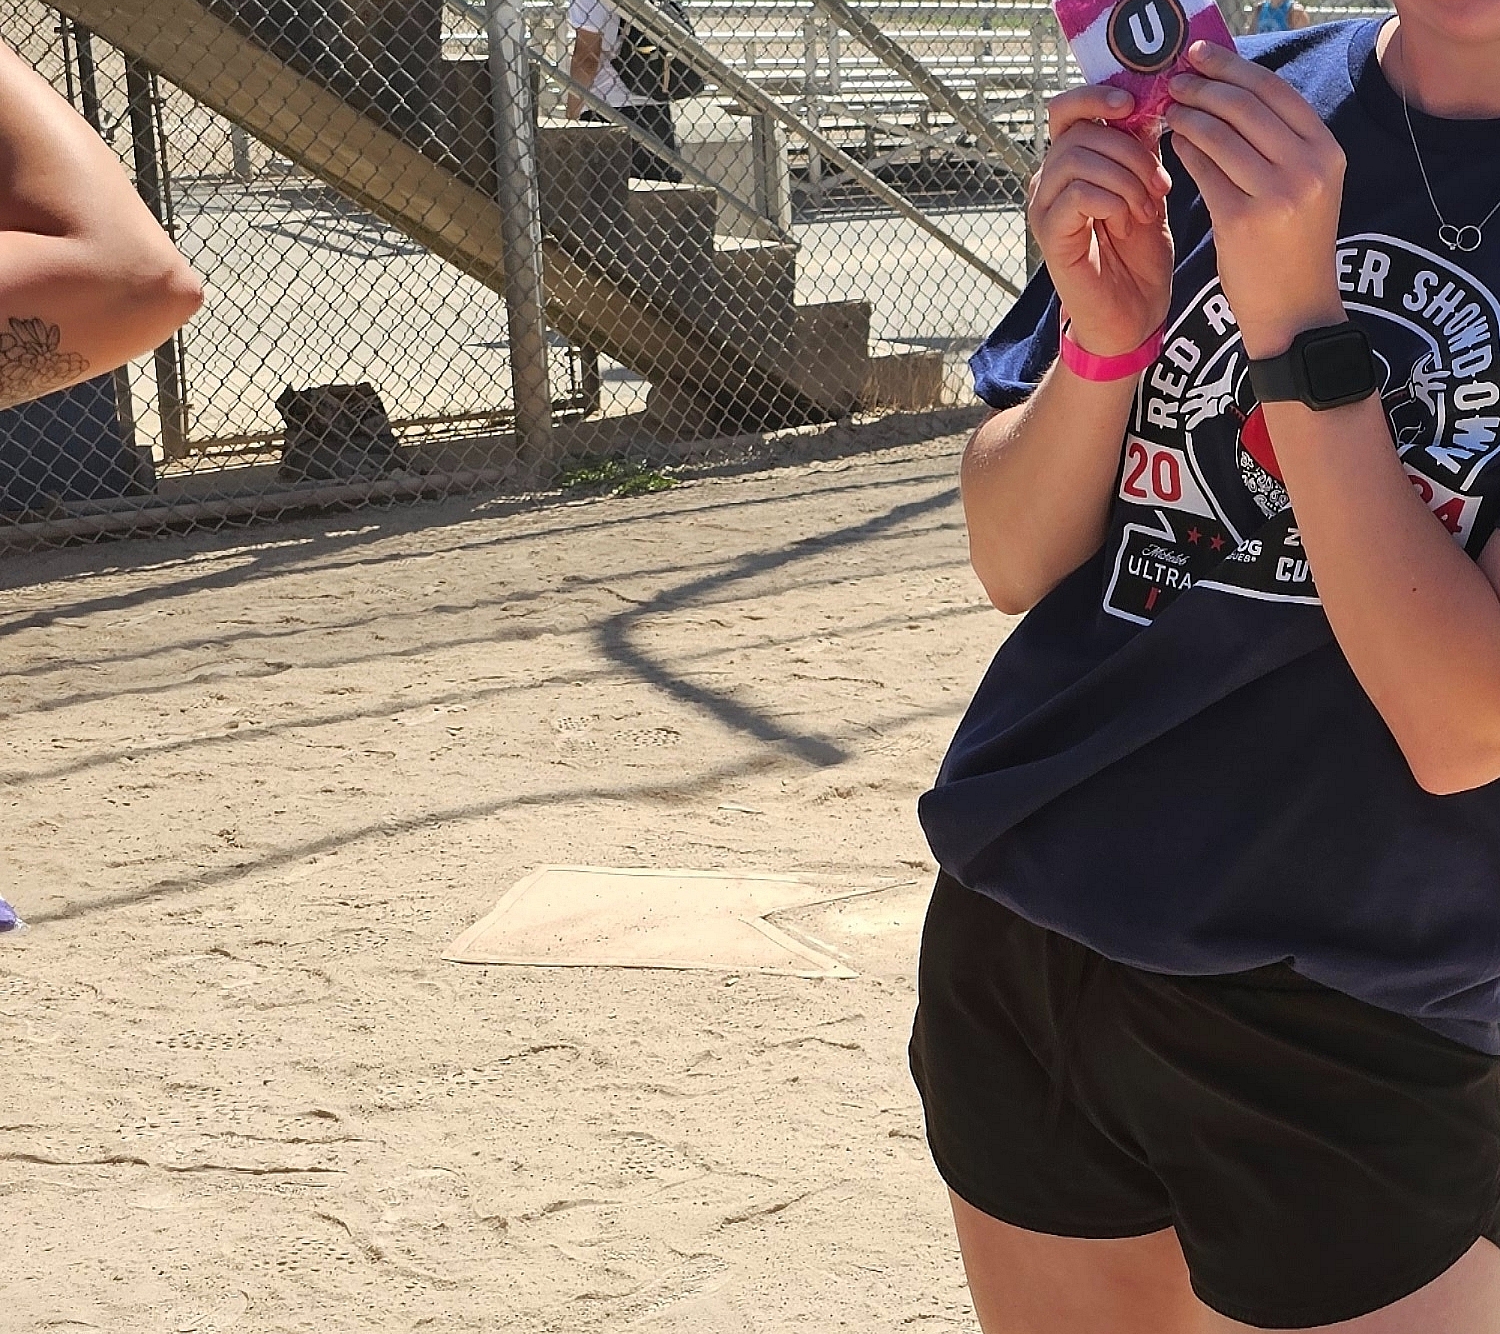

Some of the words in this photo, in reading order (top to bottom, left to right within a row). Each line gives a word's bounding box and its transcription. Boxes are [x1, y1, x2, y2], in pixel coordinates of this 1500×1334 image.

[1128, 0, 1165, 55] U
[1147, 336, 1201, 430] RED
[1202, 248, 1391, 336] RER
[1123, 442, 1182, 502] 20
[1128, 554, 1192, 590] ULTRA
[1275, 555, 1311, 583] CU
